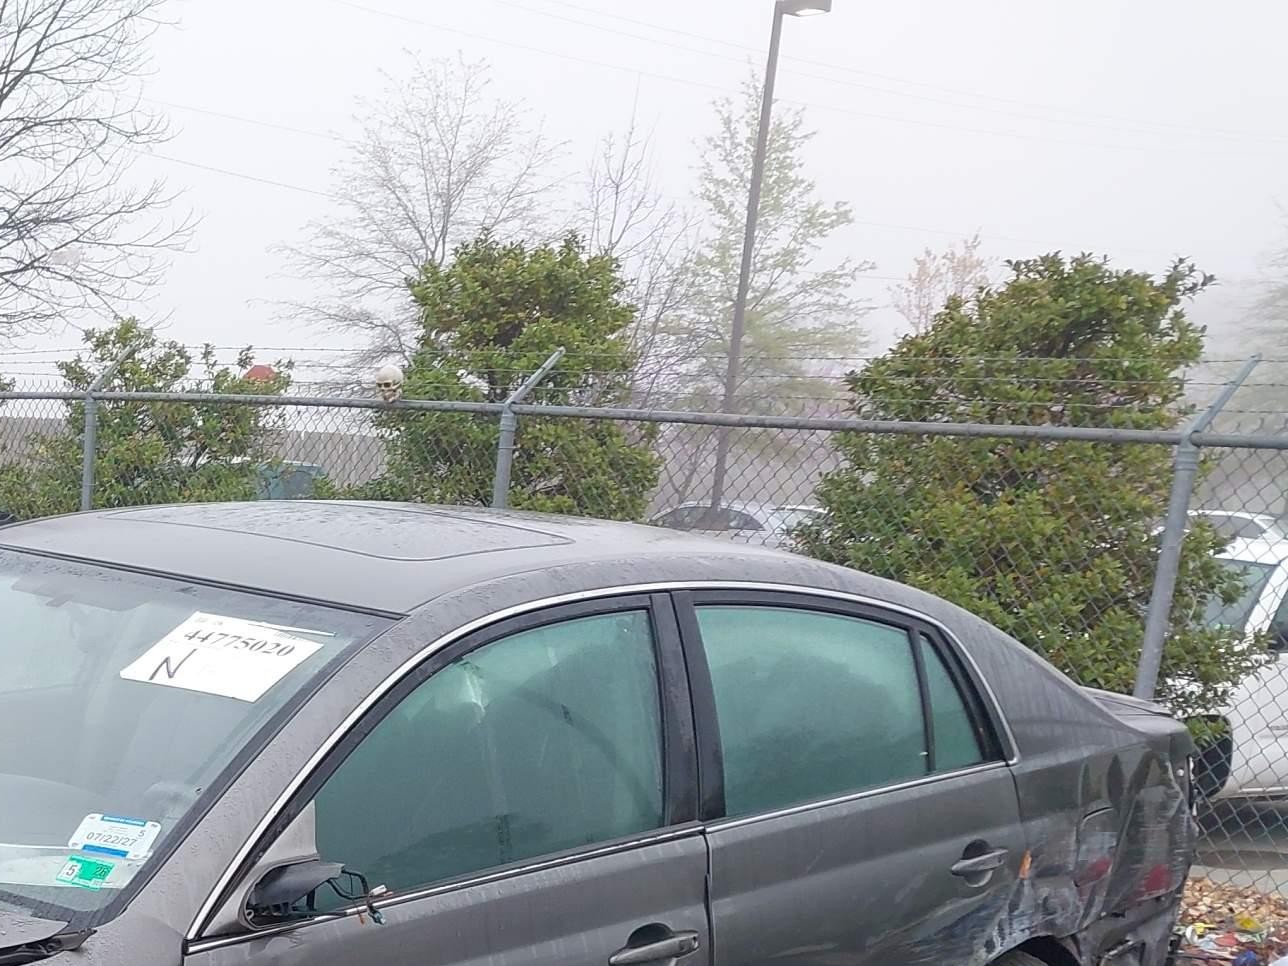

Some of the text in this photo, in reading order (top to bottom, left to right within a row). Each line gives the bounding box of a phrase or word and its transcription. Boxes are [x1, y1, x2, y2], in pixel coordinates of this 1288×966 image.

[183, 629, 296, 657] 44775020
[148, 648, 198, 681] N
[86, 831, 138, 847] 07/22/27
[66, 864, 78, 877] 5
